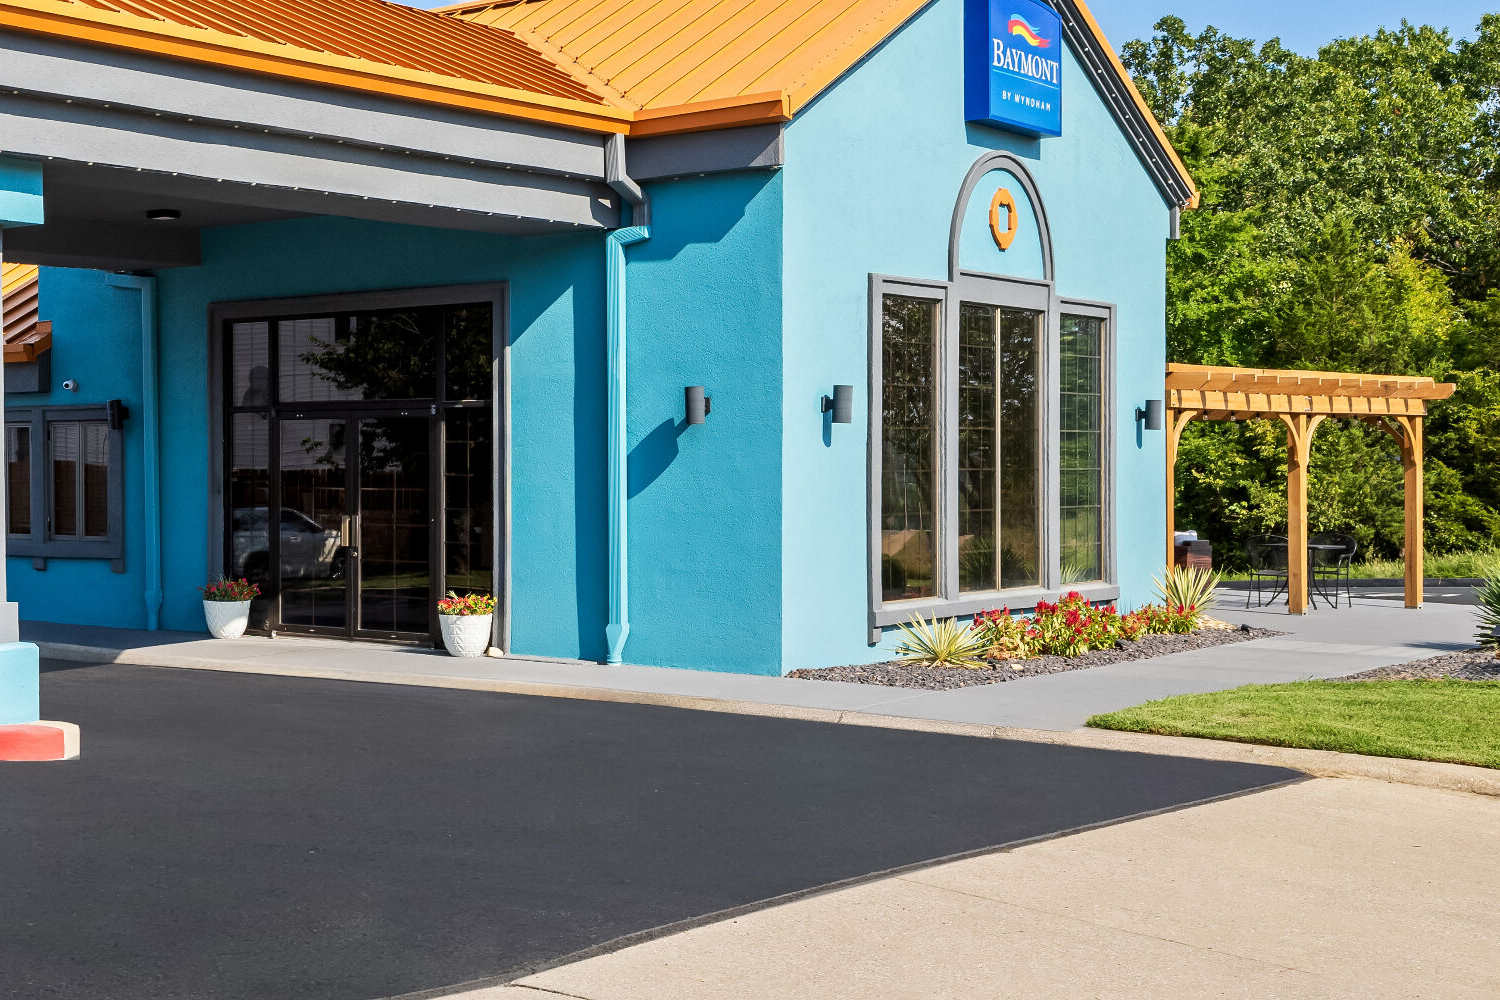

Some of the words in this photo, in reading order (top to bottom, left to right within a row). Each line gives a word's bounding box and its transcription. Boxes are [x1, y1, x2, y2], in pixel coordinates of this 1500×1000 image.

[992, 38, 1059, 84] BAYMONT
[1002, 90, 1011, 101] BY
[1014, 93, 1051, 112] WYNDHAM
